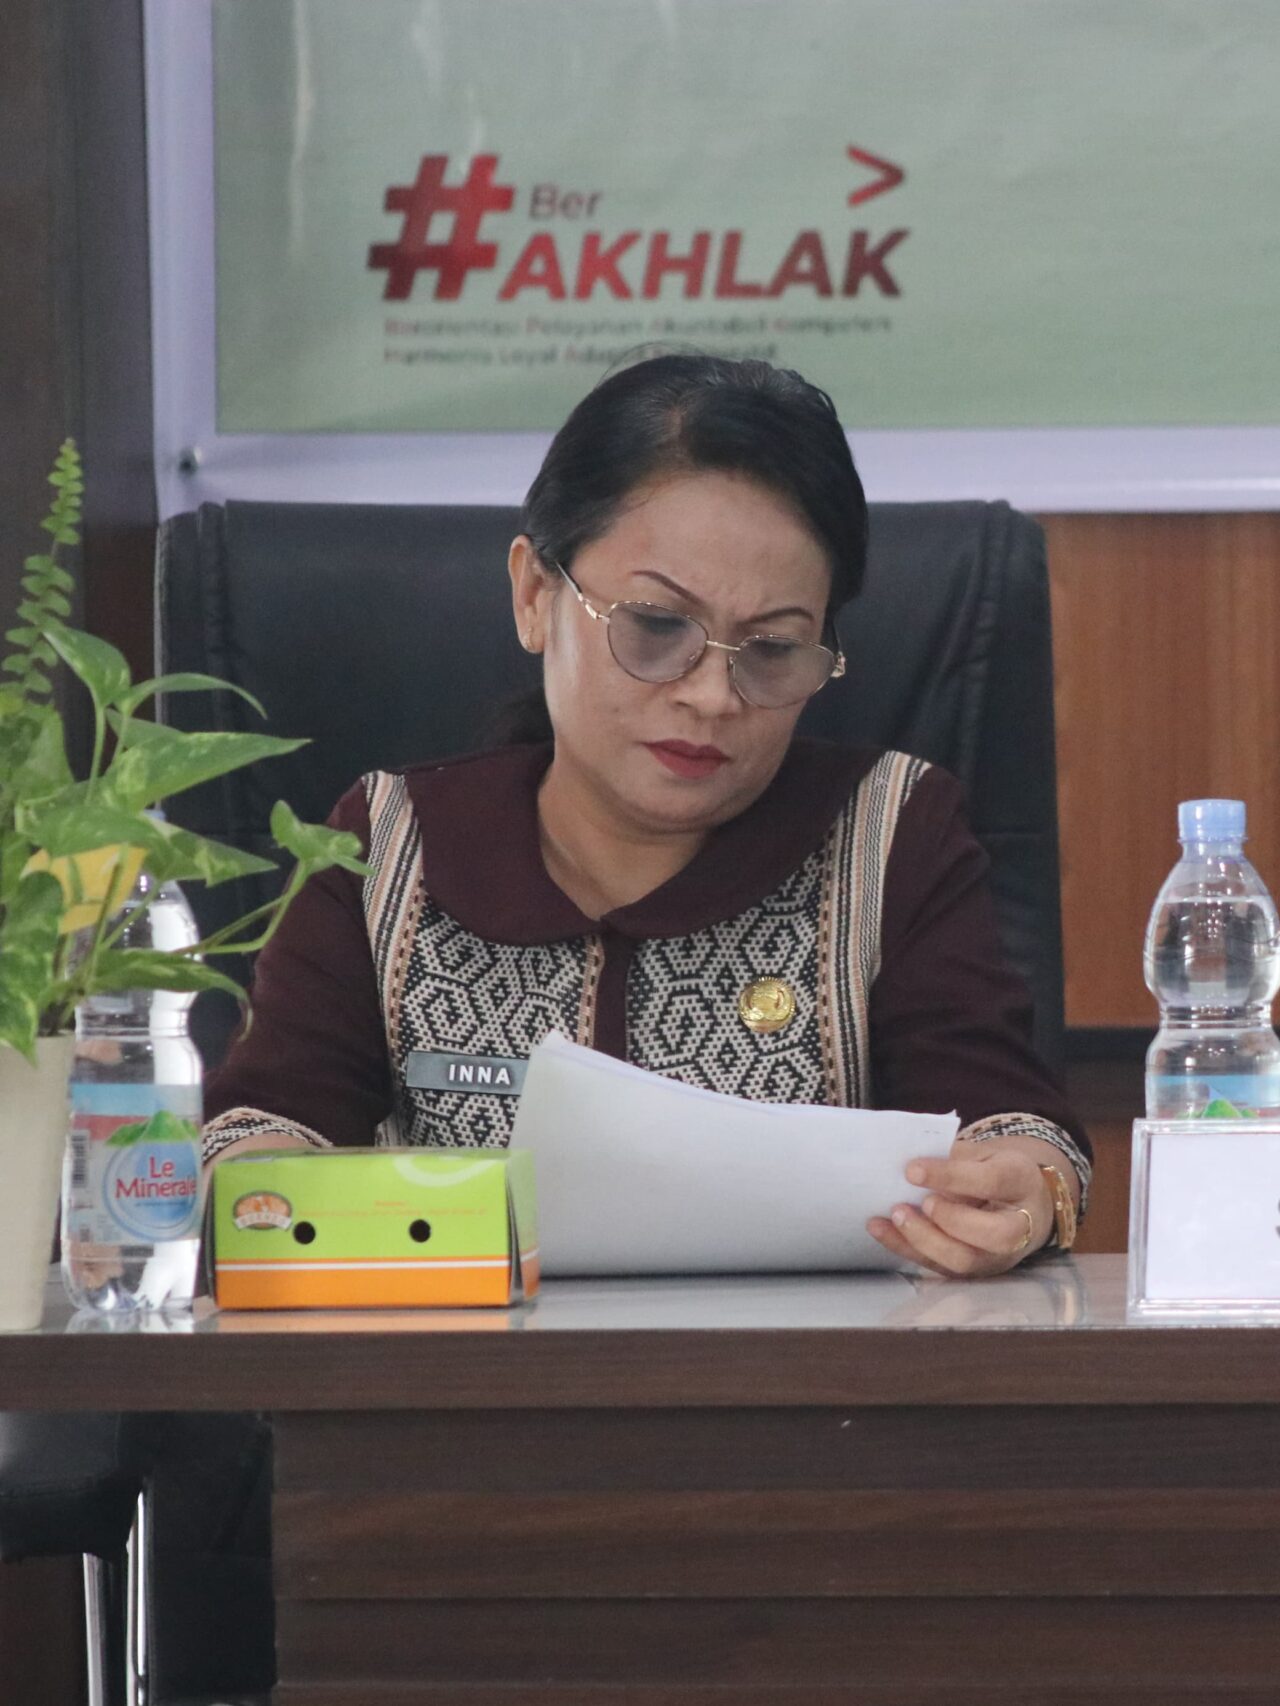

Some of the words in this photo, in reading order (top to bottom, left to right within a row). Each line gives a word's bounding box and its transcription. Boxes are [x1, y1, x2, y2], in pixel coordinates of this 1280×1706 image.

[528, 185, 603, 220] Ber
[498, 229, 910, 301] AKHLAK
[448, 1063, 511, 1086] INNA
[149, 1156, 175, 1179] Le
